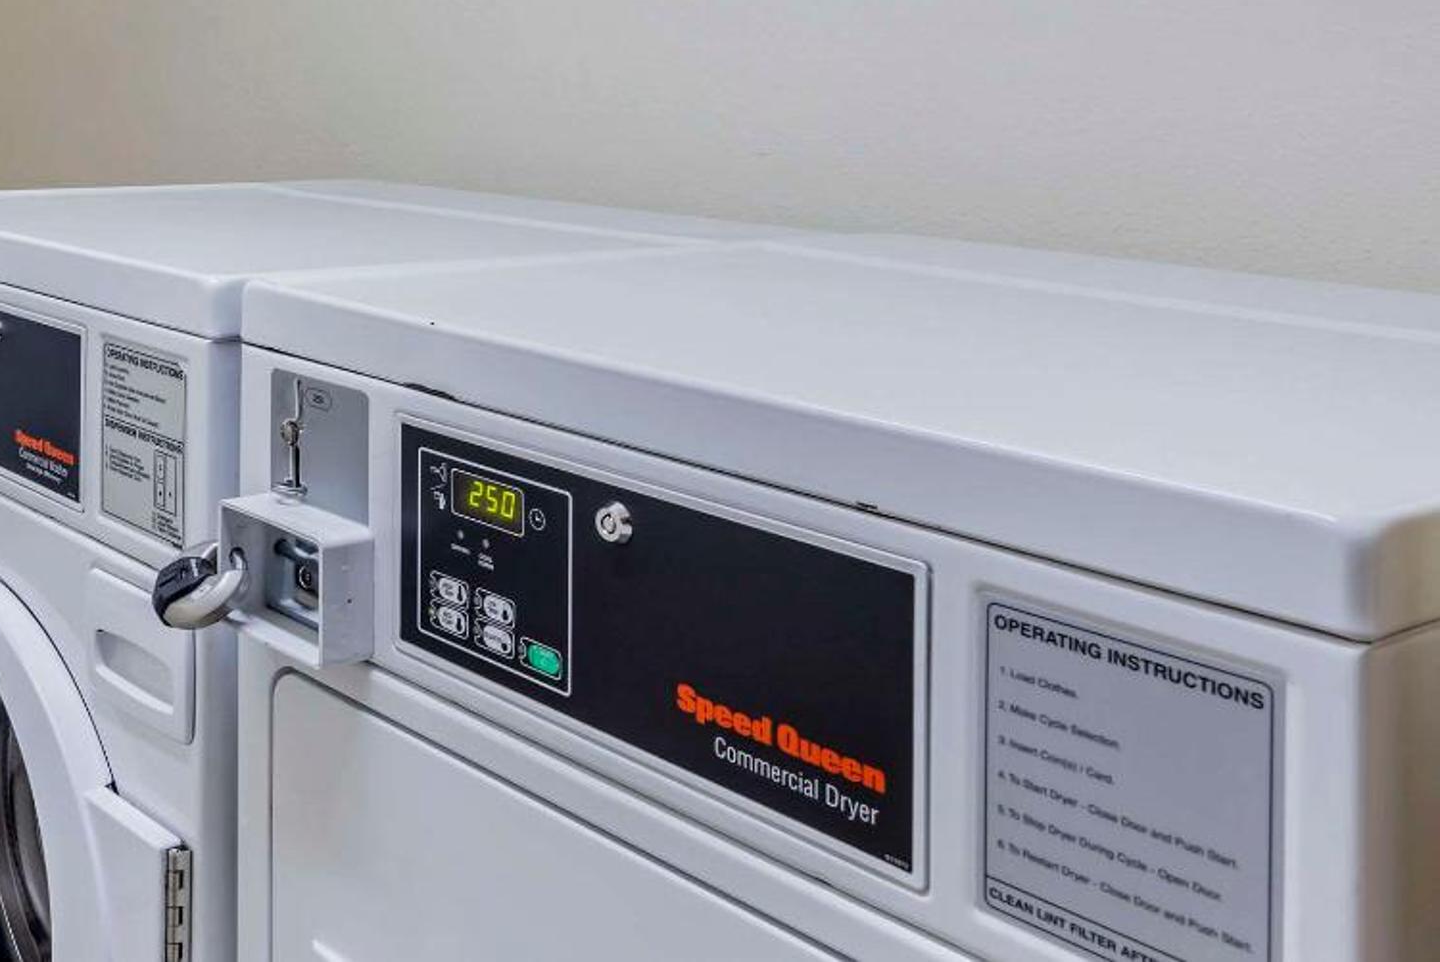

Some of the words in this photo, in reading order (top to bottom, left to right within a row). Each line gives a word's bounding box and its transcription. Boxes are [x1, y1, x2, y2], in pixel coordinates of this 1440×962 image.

[14, 429, 43, 453] Speed
[44, 440, 76, 466] Queen
[994, 614, 1101, 659] OPERATING
[1107, 648, 1264, 709] INSTRUCTIONS
[1009, 669, 1035, 685] Load
[676, 683, 772, 747] Speed
[777, 723, 887, 794] Queen
[1009, 703, 1036, 720] Make
[1038, 713, 1068, 731] Cycle
[1009, 739, 1038, 757] Insert
[714, 736, 819, 801] Commercial
[824, 782, 880, 825] Dryer
[1008, 772, 1021, 786] To
[1022, 779, 1047, 796] Start
[1049, 788, 1078, 807] Dryer
[1087, 804, 1118, 823] Close
[1120, 816, 1147, 833] Door
[1150, 829, 1172, 845] and
[1174, 837, 1205, 857] Push
[1008, 807, 1021, 820] To
[1022, 814, 1047, 832] Stop
[1048, 824, 1077, 842] Dryer
[1079, 837, 1114, 860] During
[1116, 852, 1148, 871] Cycle
[1157, 868, 1189, 889] Open
[989, 887, 1034, 916] CLEAN
[1036, 908, 1066, 929] LINT
[1069, 923, 1117, 952] FILTER
[1120, 945, 1158, 962] AFT
[1008, 842, 1021, 855] To
[1022, 849, 1059, 871] Restart
[1061, 865, 1090, 884] Dryer
[1100, 882, 1131, 902] Close
[1133, 896, 1160, 914] Door
[1163, 910, 1185, 926] and
[1187, 918, 1219, 938] Push
